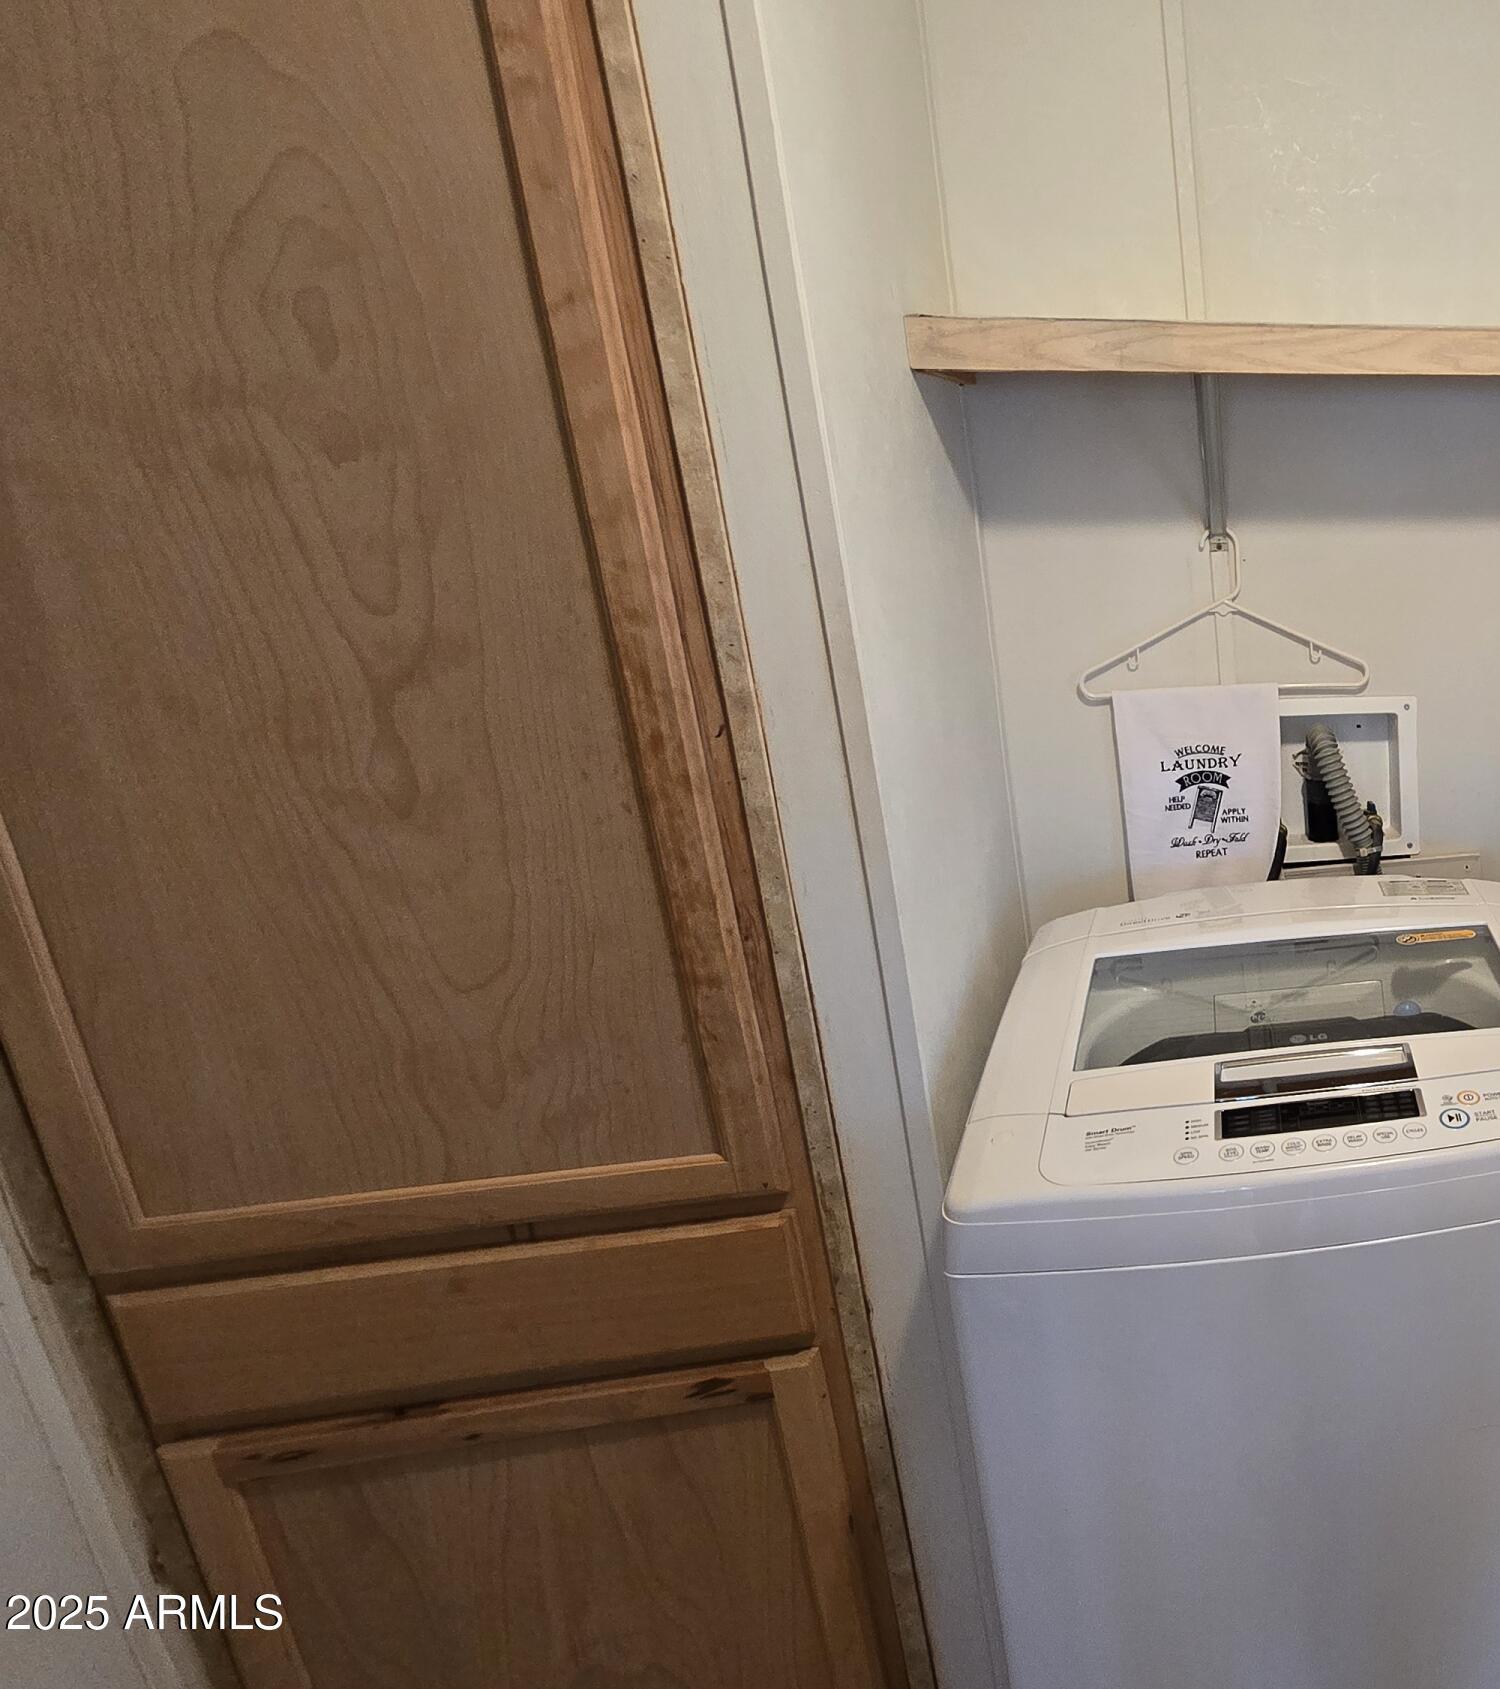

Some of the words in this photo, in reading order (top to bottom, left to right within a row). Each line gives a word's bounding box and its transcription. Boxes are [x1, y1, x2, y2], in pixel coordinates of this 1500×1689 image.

[1174, 744, 1226, 758] WELCOME
[1160, 753, 1242, 772] LAUNDRY
[1182, 771, 1223, 787] ROOM
[1168, 796, 1186, 804] HELP
[1164, 803, 1192, 812] NEEDED
[1221, 815, 1249, 823] WITHIN
[1202, 833, 1220, 848] Dry
[1195, 847, 1228, 859] REPEAT
